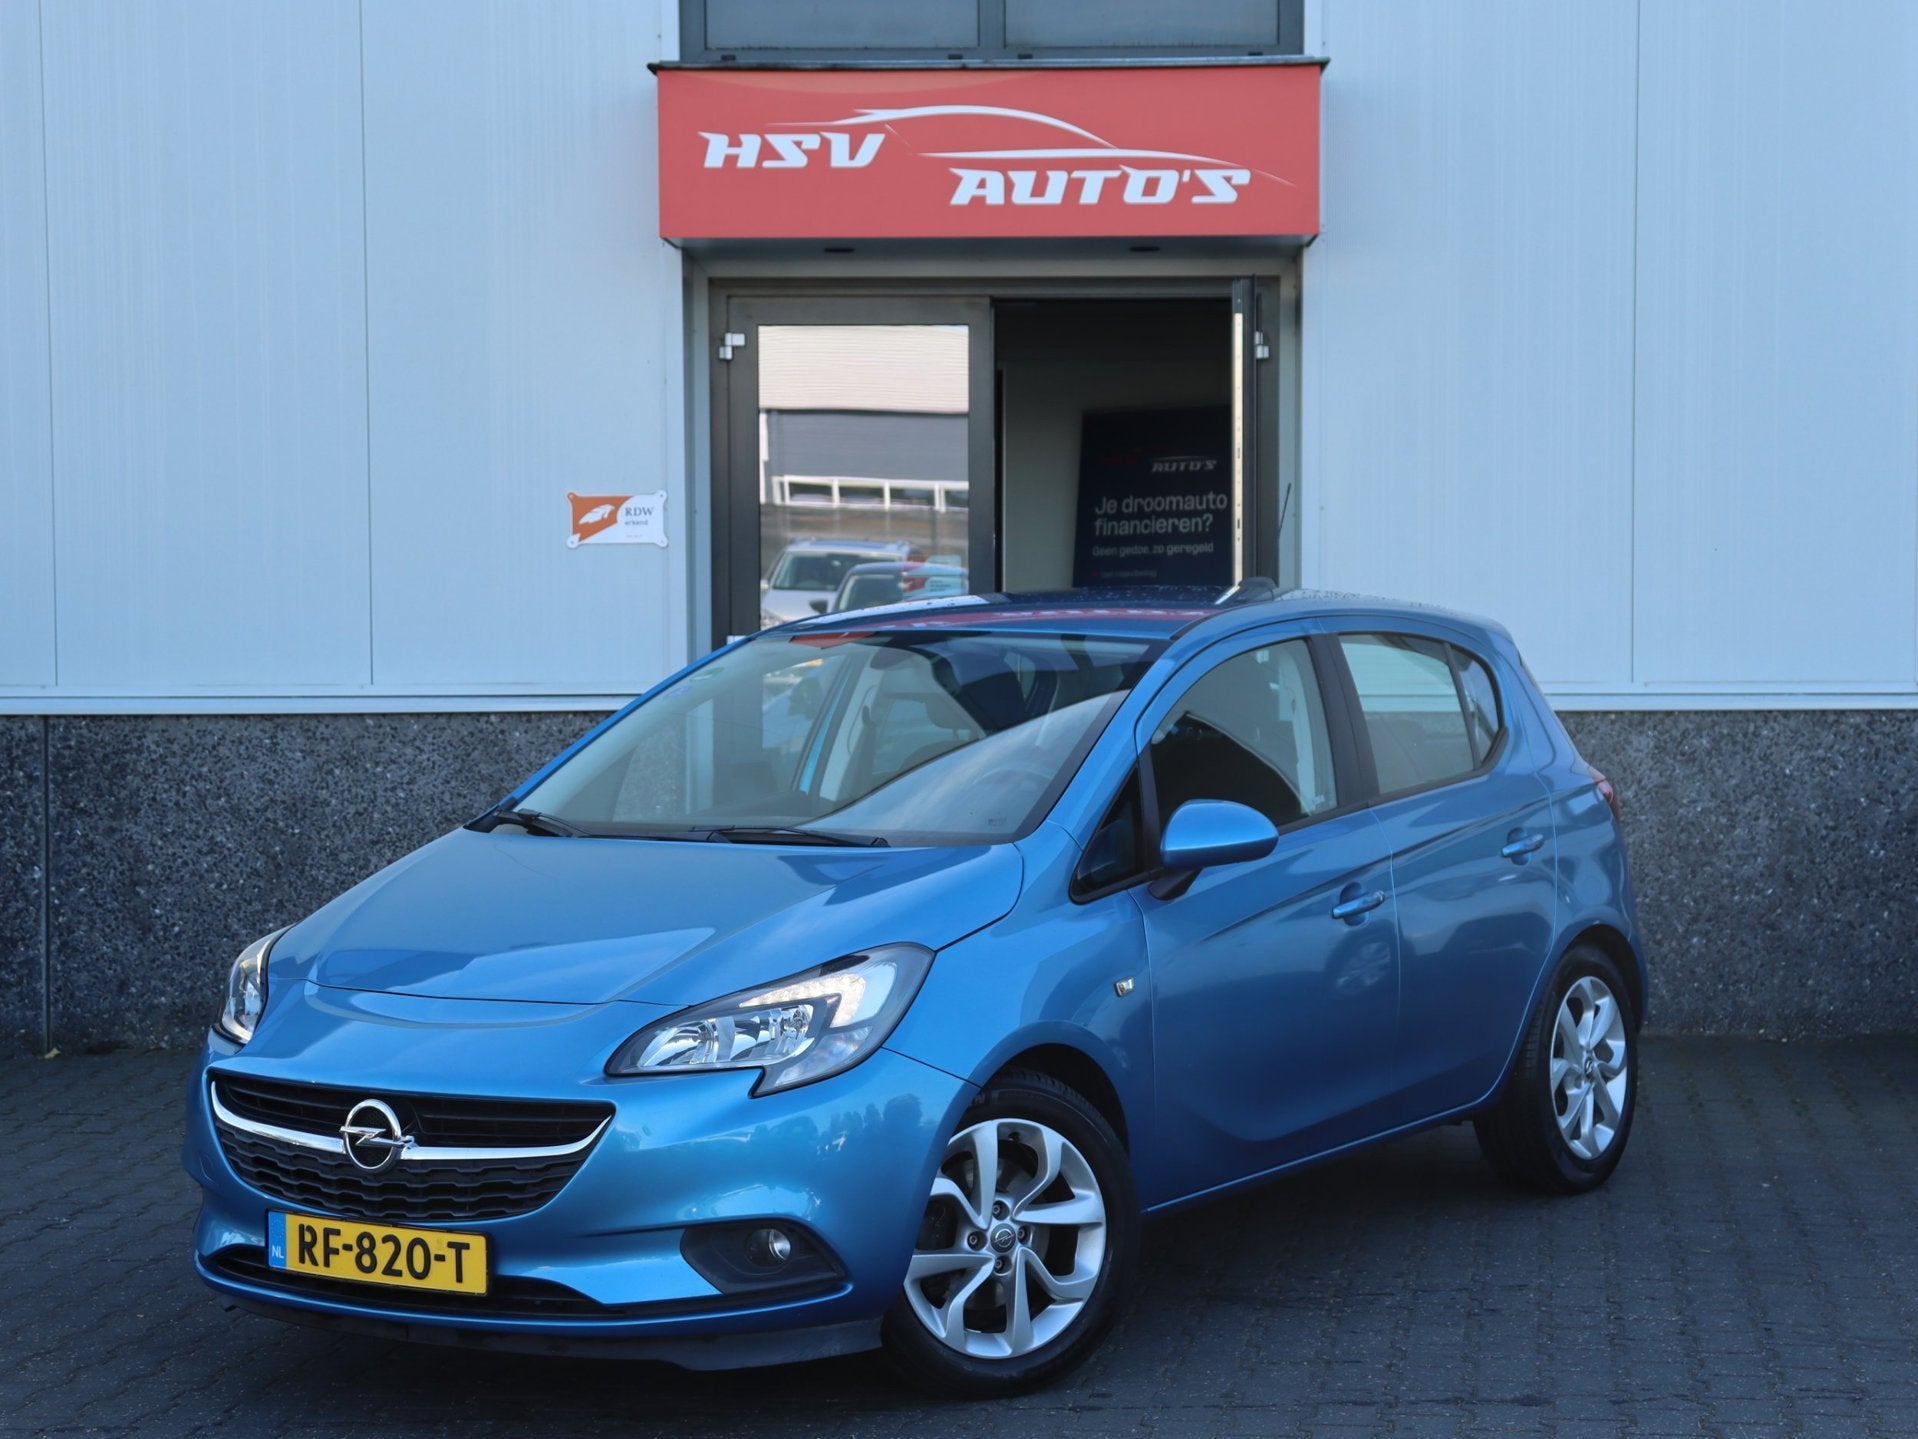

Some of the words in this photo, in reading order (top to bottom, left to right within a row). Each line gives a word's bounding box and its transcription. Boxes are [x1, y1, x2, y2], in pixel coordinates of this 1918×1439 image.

[698, 131, 886, 169] HSV
[949, 164, 1251, 205] AUTO'S
[625, 506, 654, 517] RDW
[1095, 497, 1117, 514] Je
[1122, 491, 1228, 513] droomauto
[1094, 514, 1213, 536] financieren?
[1092, 545, 1117, 556] Geen
[1152, 545, 1164, 553] zo
[1166, 542, 1214, 556] geregeld
[272, 1245, 284, 1259] NL
[298, 1223, 470, 1283] RF-820-T
